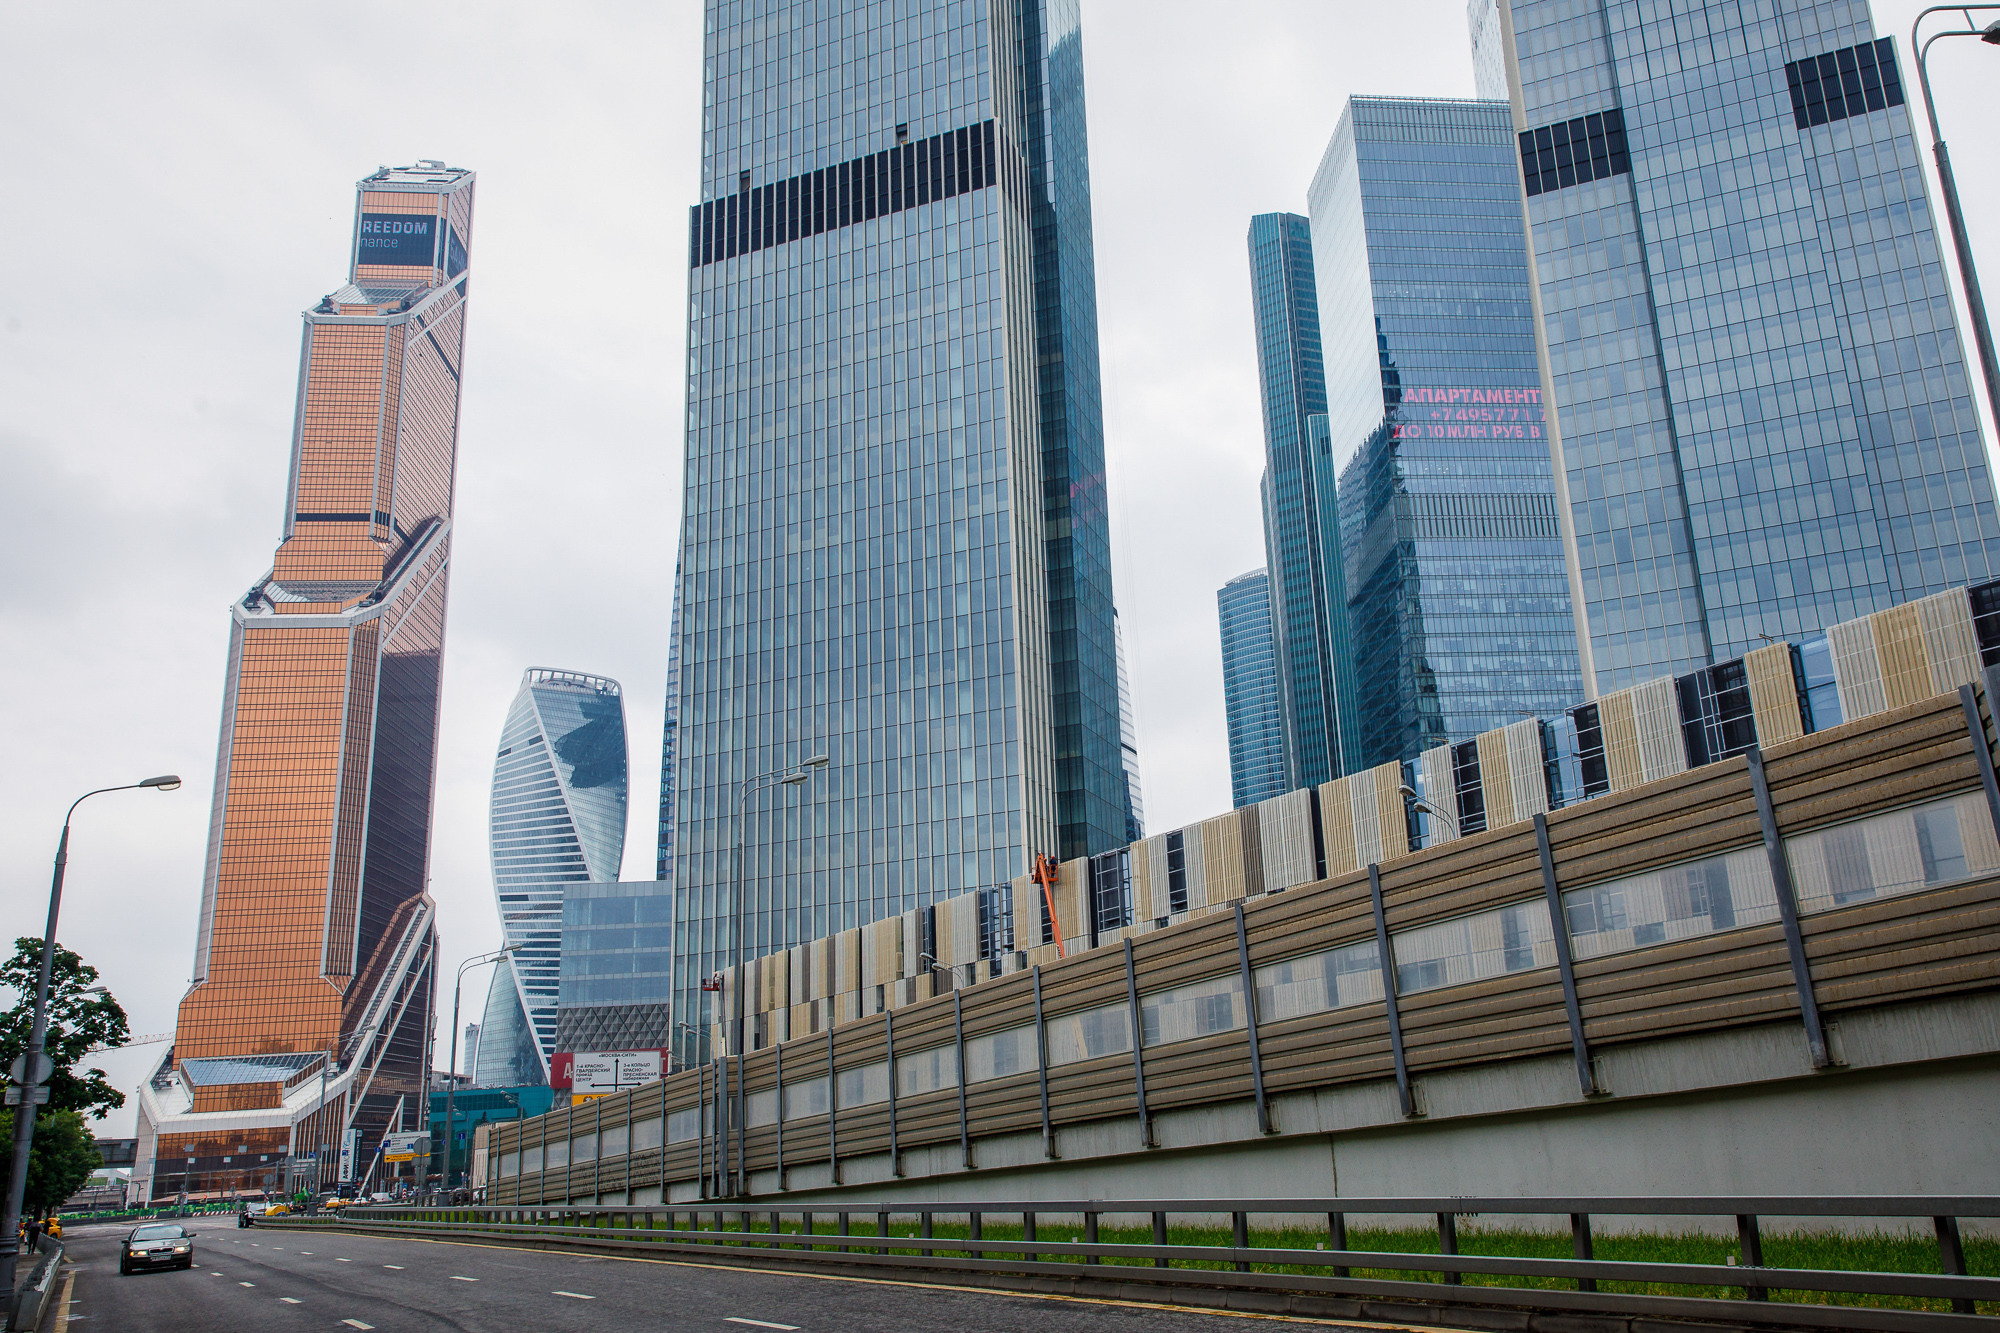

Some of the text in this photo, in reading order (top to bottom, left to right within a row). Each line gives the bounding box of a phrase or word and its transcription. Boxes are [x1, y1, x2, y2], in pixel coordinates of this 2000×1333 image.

[363, 221, 428, 234] REEDOM
[1404, 388, 1544, 403] АПАРТАМЕНТ
[1393, 424, 1421, 438] ДО
[1492, 424, 1524, 438] РУБ
